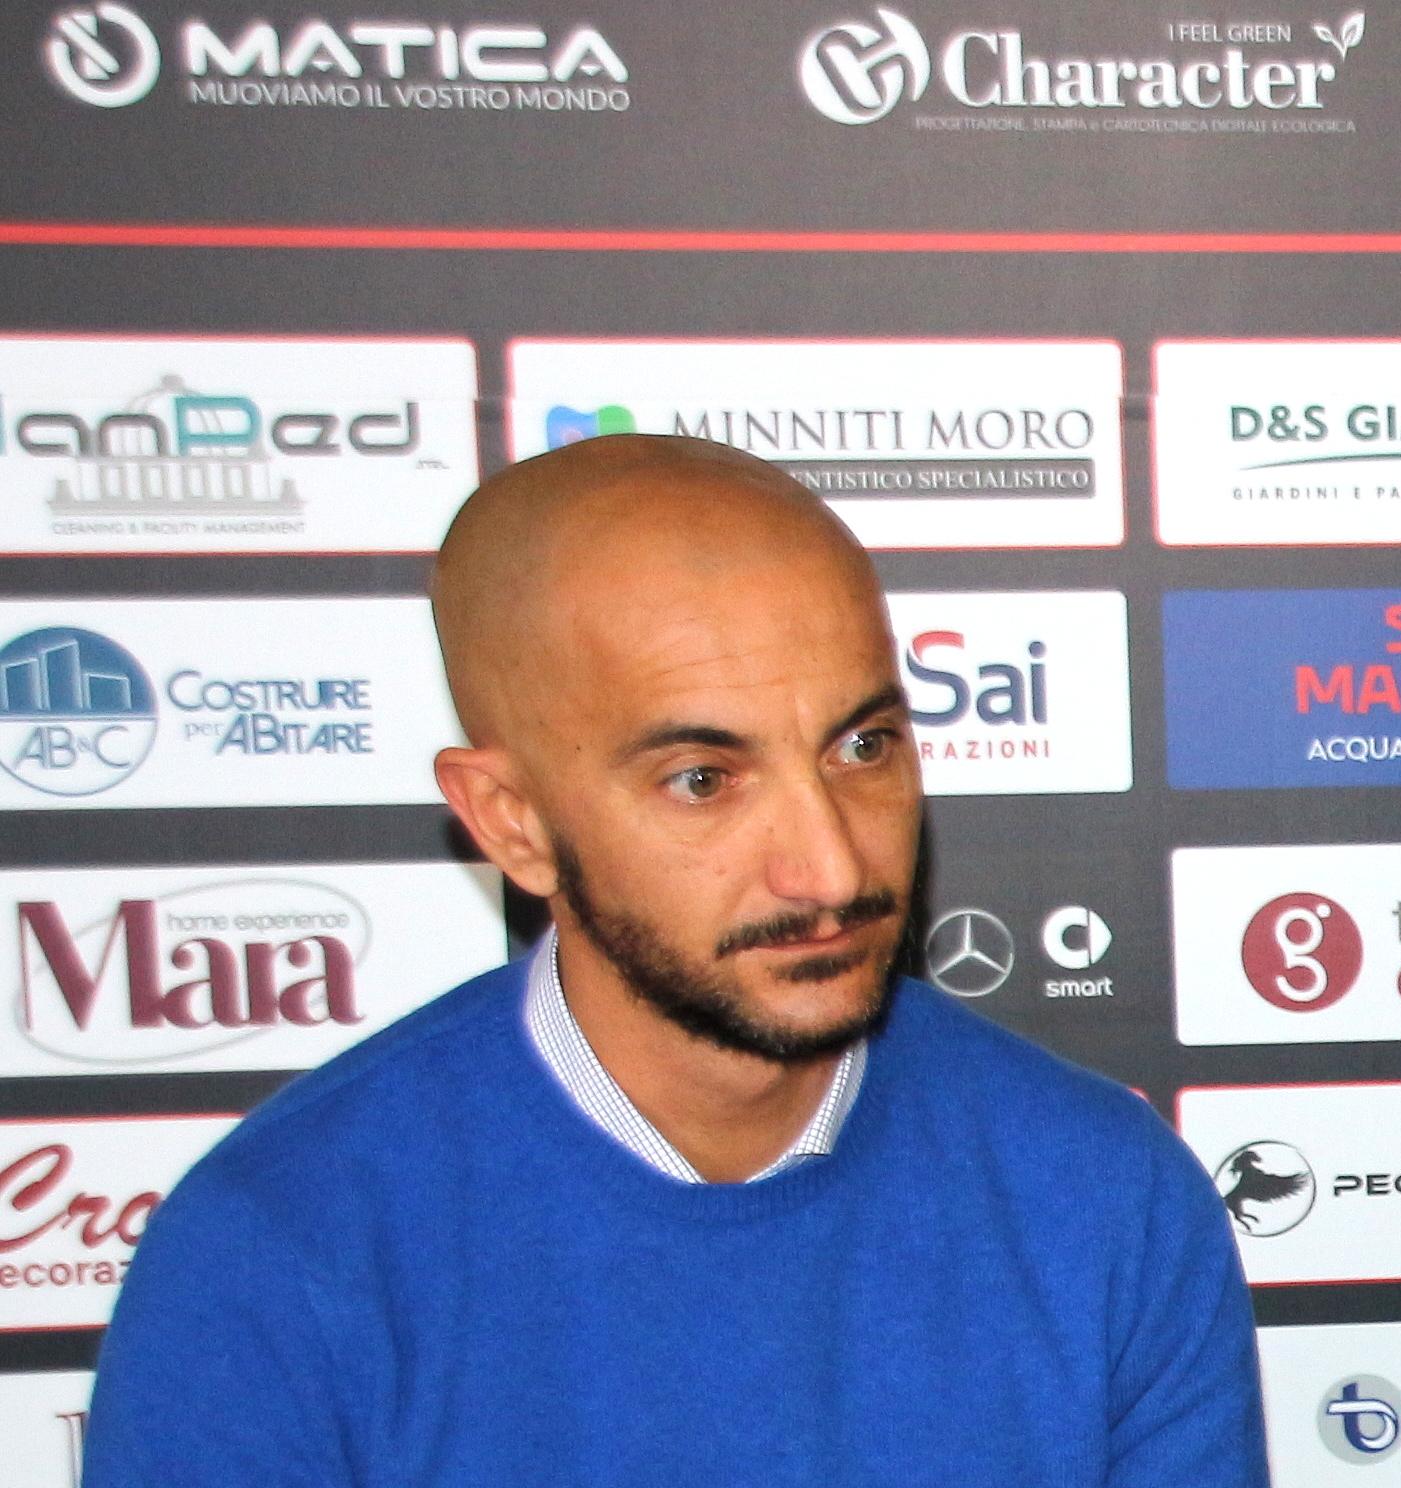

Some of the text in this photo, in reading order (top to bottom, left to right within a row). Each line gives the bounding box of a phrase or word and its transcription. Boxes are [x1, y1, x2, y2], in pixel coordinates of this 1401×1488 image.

[1179, 24, 1223, 42] FEEL
[1228, 23, 1292, 42] GREEN
[183, 21, 629, 82] MATICA
[943, 28, 1336, 109] Character
[190, 82, 630, 112] MUOVIAMO IL VOSTRO MONDO
[673, 408, 1095, 451] MINNITI MORO
[1230, 404, 1329, 442] D&S
[917, 469, 1089, 490] SPECIALISTICO
[1232, 487, 1340, 500] GIARDINI
[906, 630, 1048, 727] Sai
[185, 721, 225, 742] per
[920, 740, 1050, 760] RAZIONI
[167, 912, 349, 934] home experience
[18, 899, 367, 1031] Mara
[1045, 974, 1114, 998] smart
